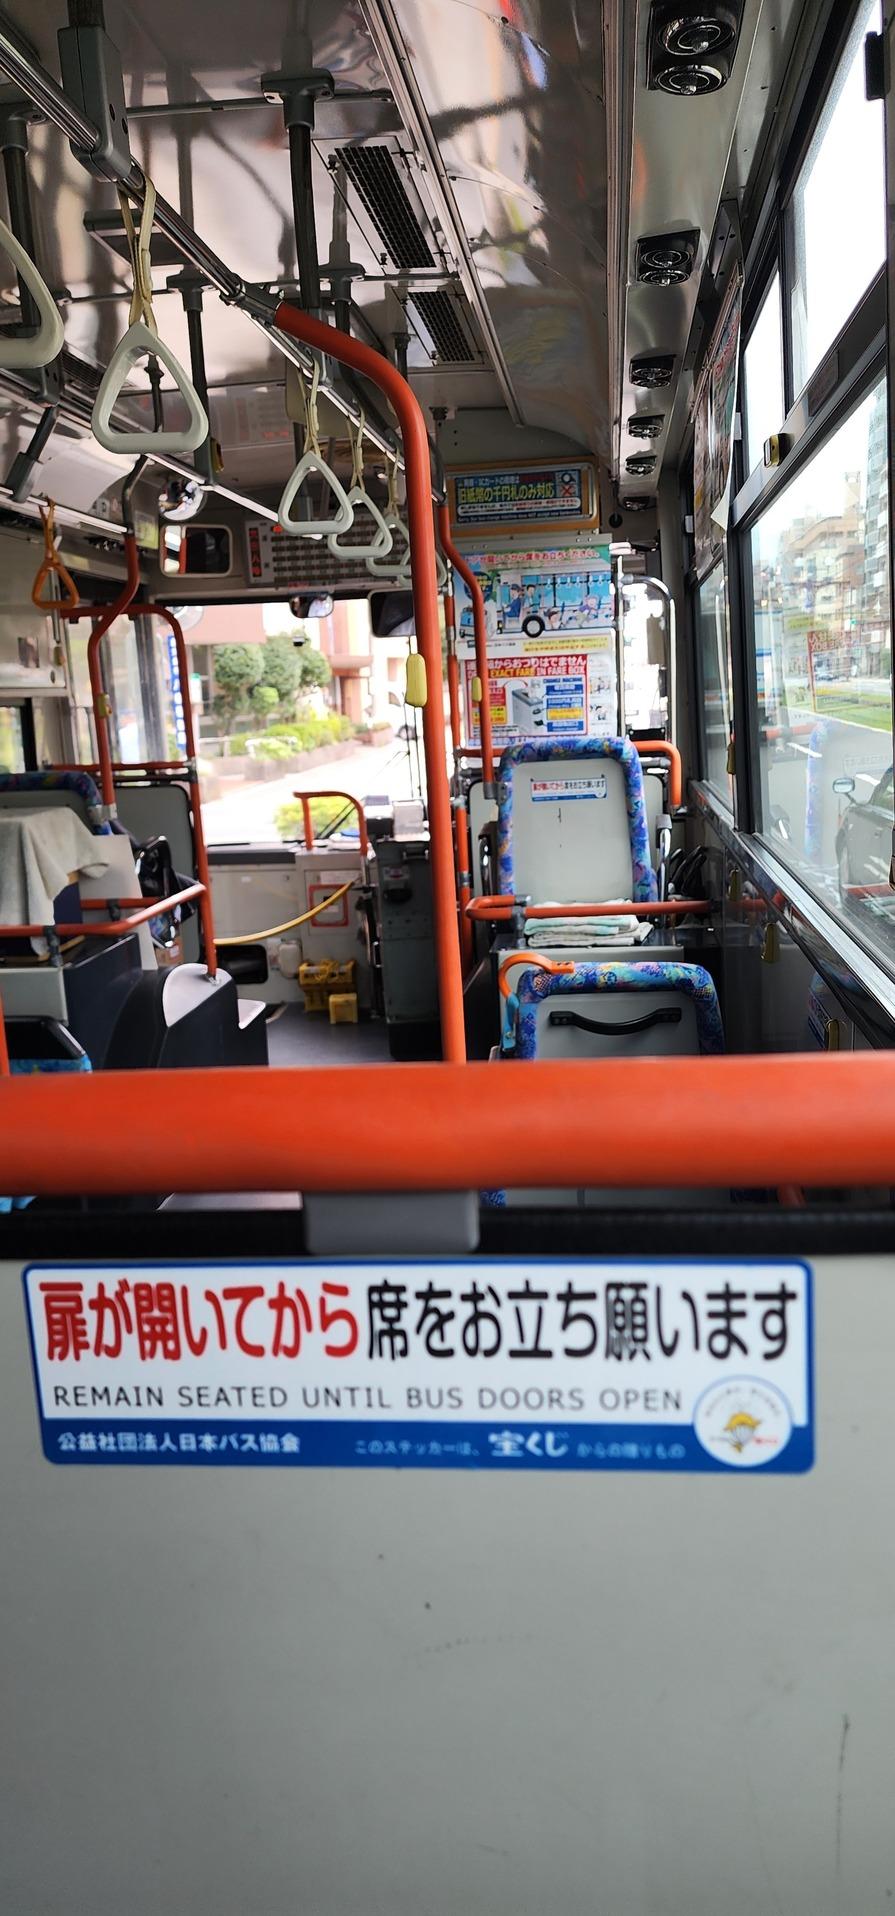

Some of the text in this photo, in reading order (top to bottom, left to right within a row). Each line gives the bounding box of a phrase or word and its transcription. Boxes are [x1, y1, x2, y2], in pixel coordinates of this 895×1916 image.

[491, 668, 514, 677] EXACT
[516, 667, 535, 676] FARE
[537, 667, 546, 676] IN
[548, 666, 567, 675] FARE
[568, 665, 585, 674] BOX
[39, 1278, 798, 1362] 扉が開いてから席をお立ち願います
[53, 1386, 164, 1408] REMAIN
[178, 1386, 288, 1408] SEATED
[302, 1386, 391, 1409] UNTIL
[406, 1387, 463, 1410] BUS
[478, 1387, 585, 1411] DOORS
[602, 1388, 682, 1412] OPEN
[57, 1432, 301, 1453] 公益社団法人日本バス協会
[488, 1430, 569, 1458] 宝くじ
[576, 1441, 686, 1459] からの贈りもの
